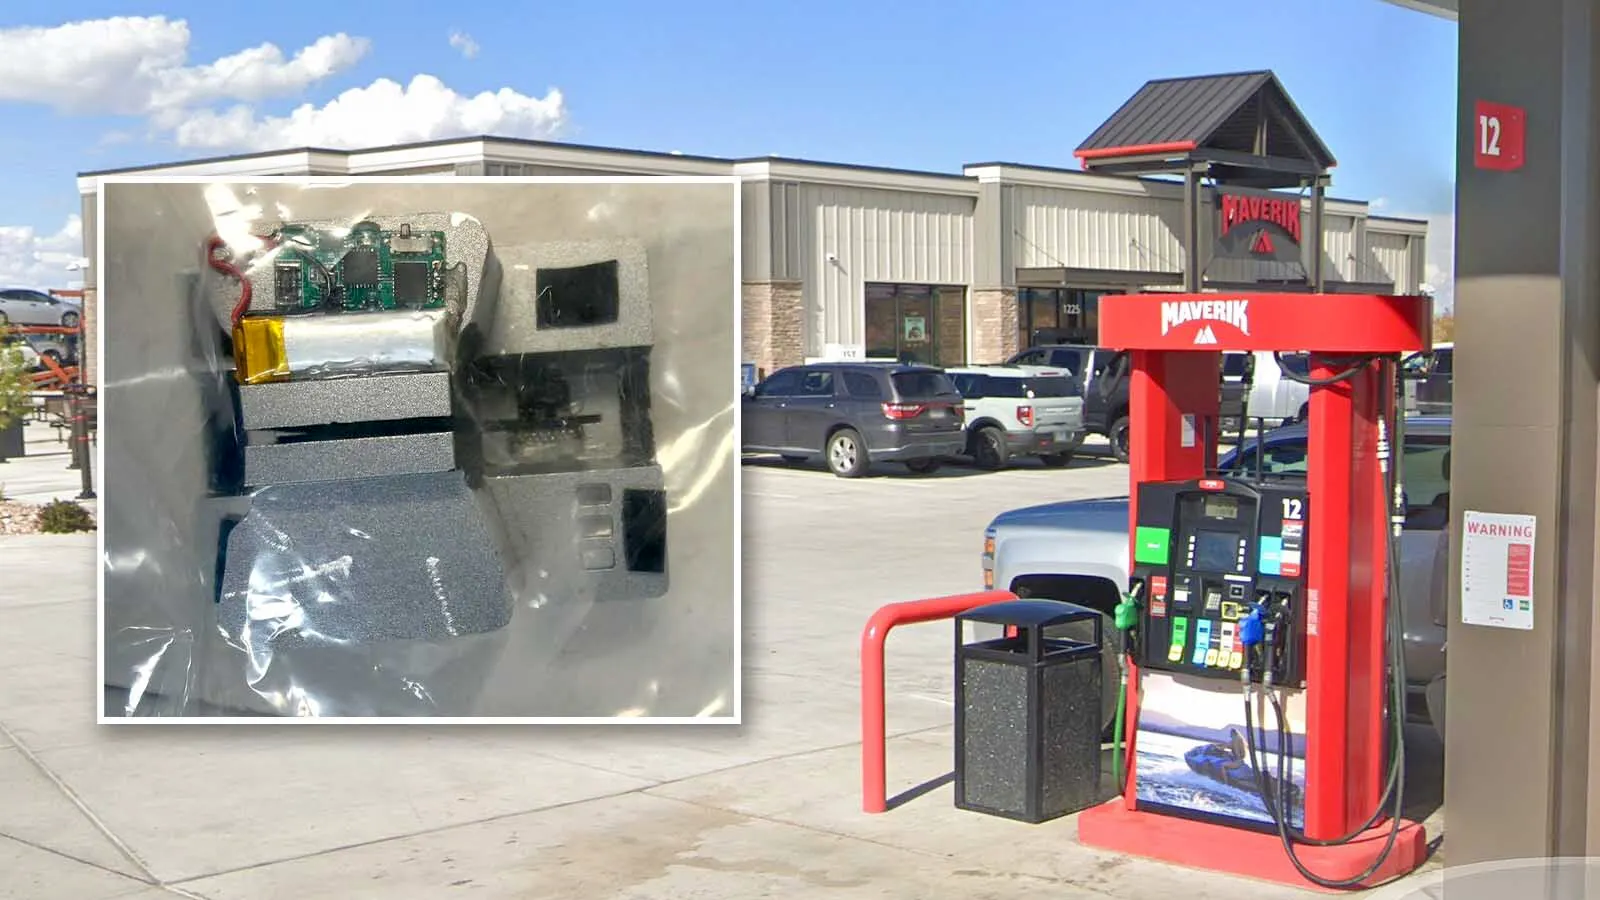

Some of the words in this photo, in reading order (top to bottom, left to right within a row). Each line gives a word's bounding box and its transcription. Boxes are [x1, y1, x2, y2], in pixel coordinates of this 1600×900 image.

[1480, 115, 1500, 155] 12
[1222, 194, 1301, 242] MAVERIK
[1161, 300, 1250, 336] MAVERIK
[1282, 498, 1302, 519] 12
[1467, 521, 1533, 537] WARNING
